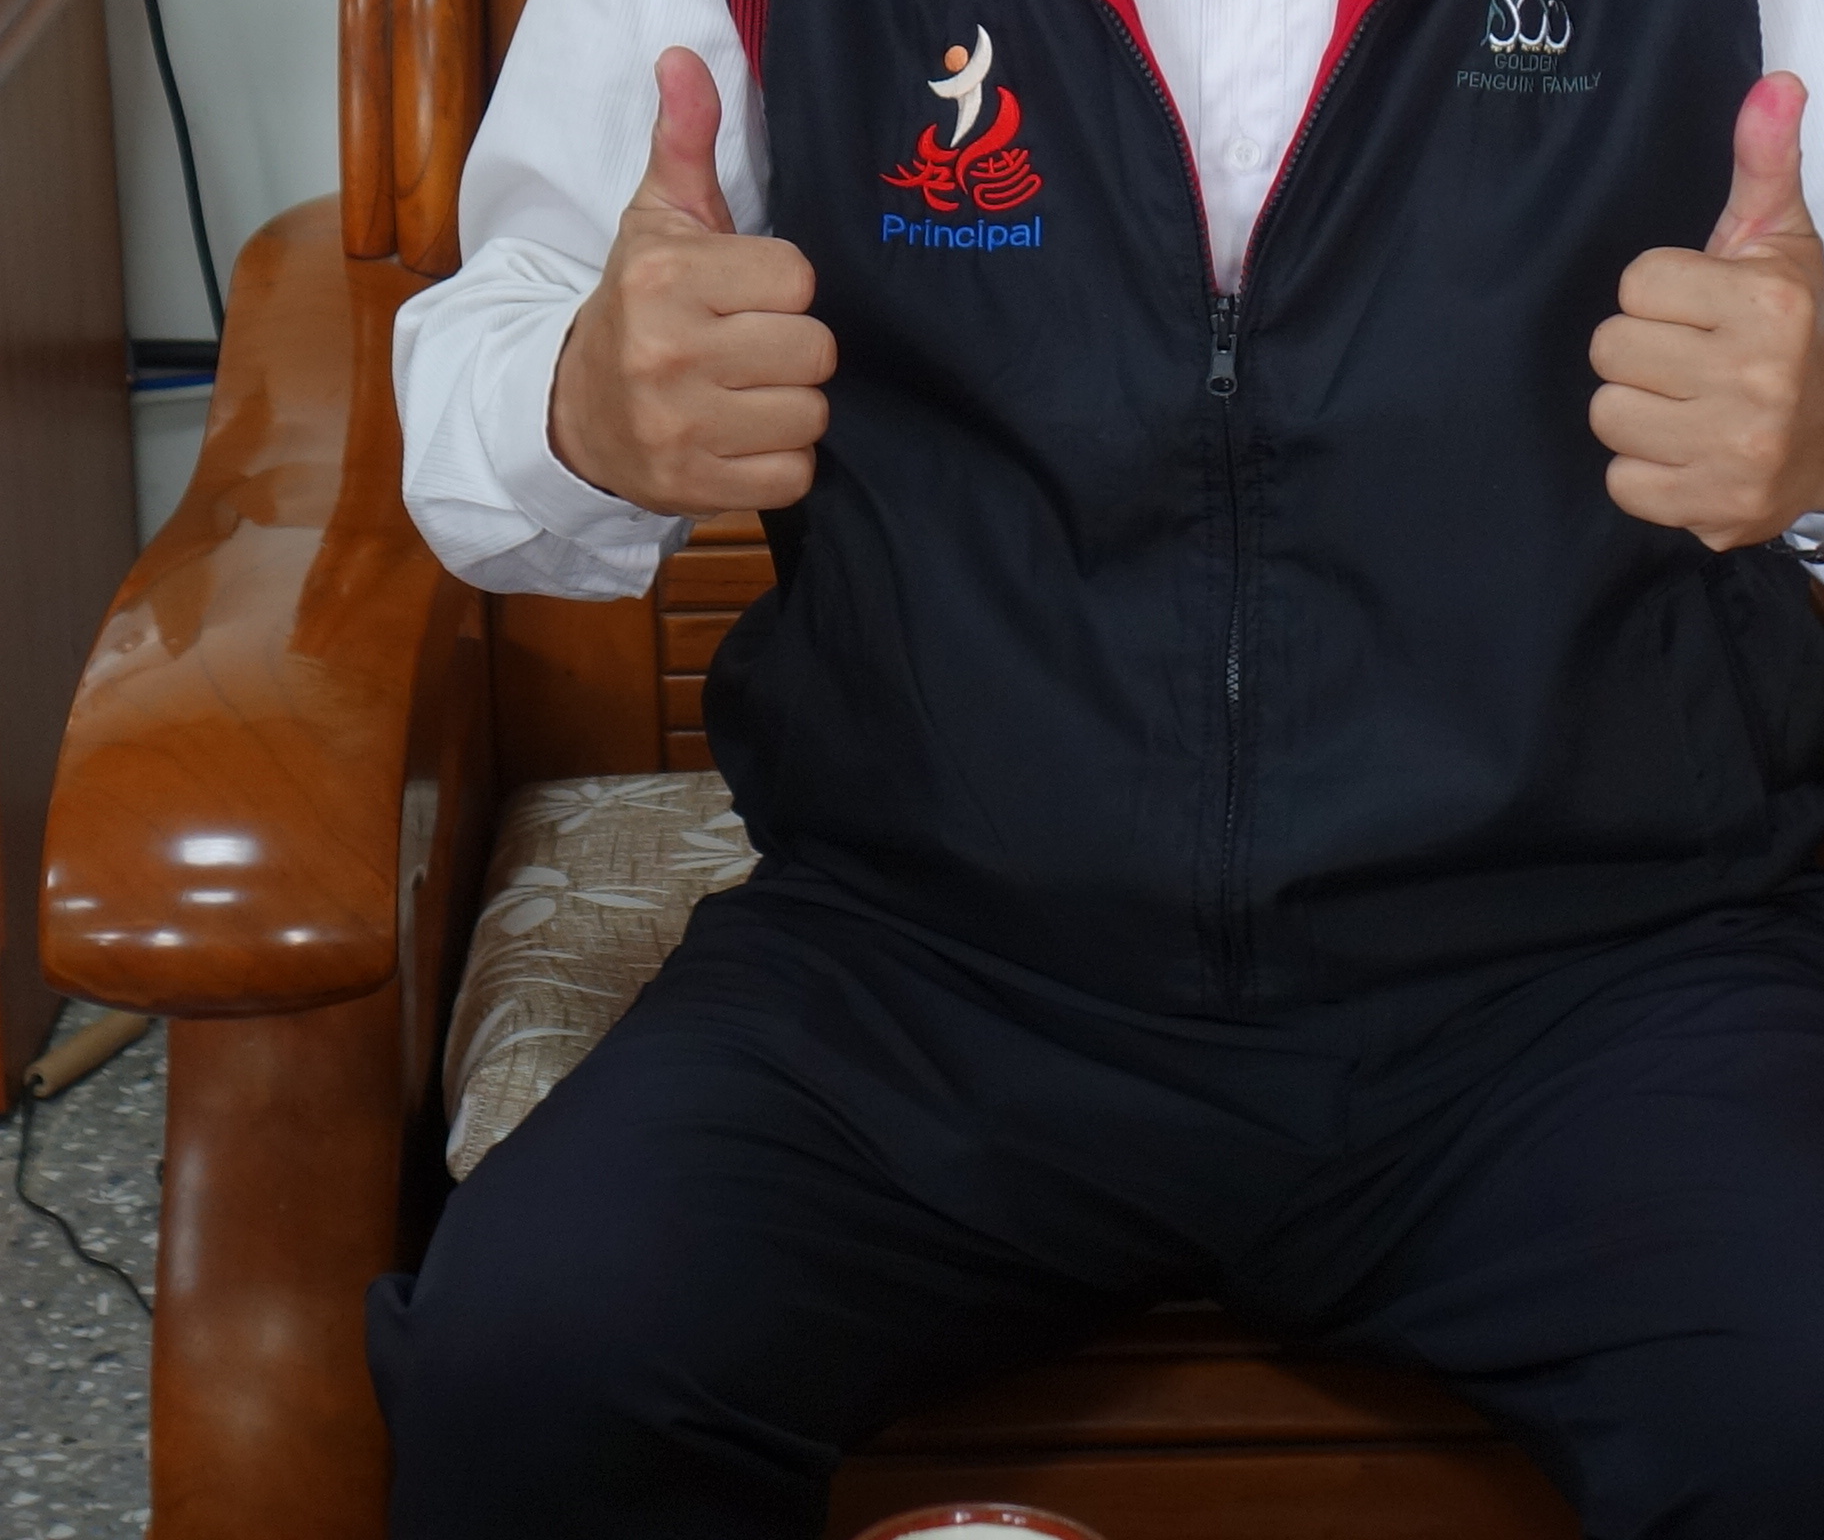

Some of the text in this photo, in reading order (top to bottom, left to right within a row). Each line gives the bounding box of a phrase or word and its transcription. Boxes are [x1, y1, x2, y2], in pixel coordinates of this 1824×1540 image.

[1495, 53, 1558, 72] GOLDEN
[1457, 71, 1602, 93] PENGUIN FAMILY
[882, 214, 1043, 251] Principal
